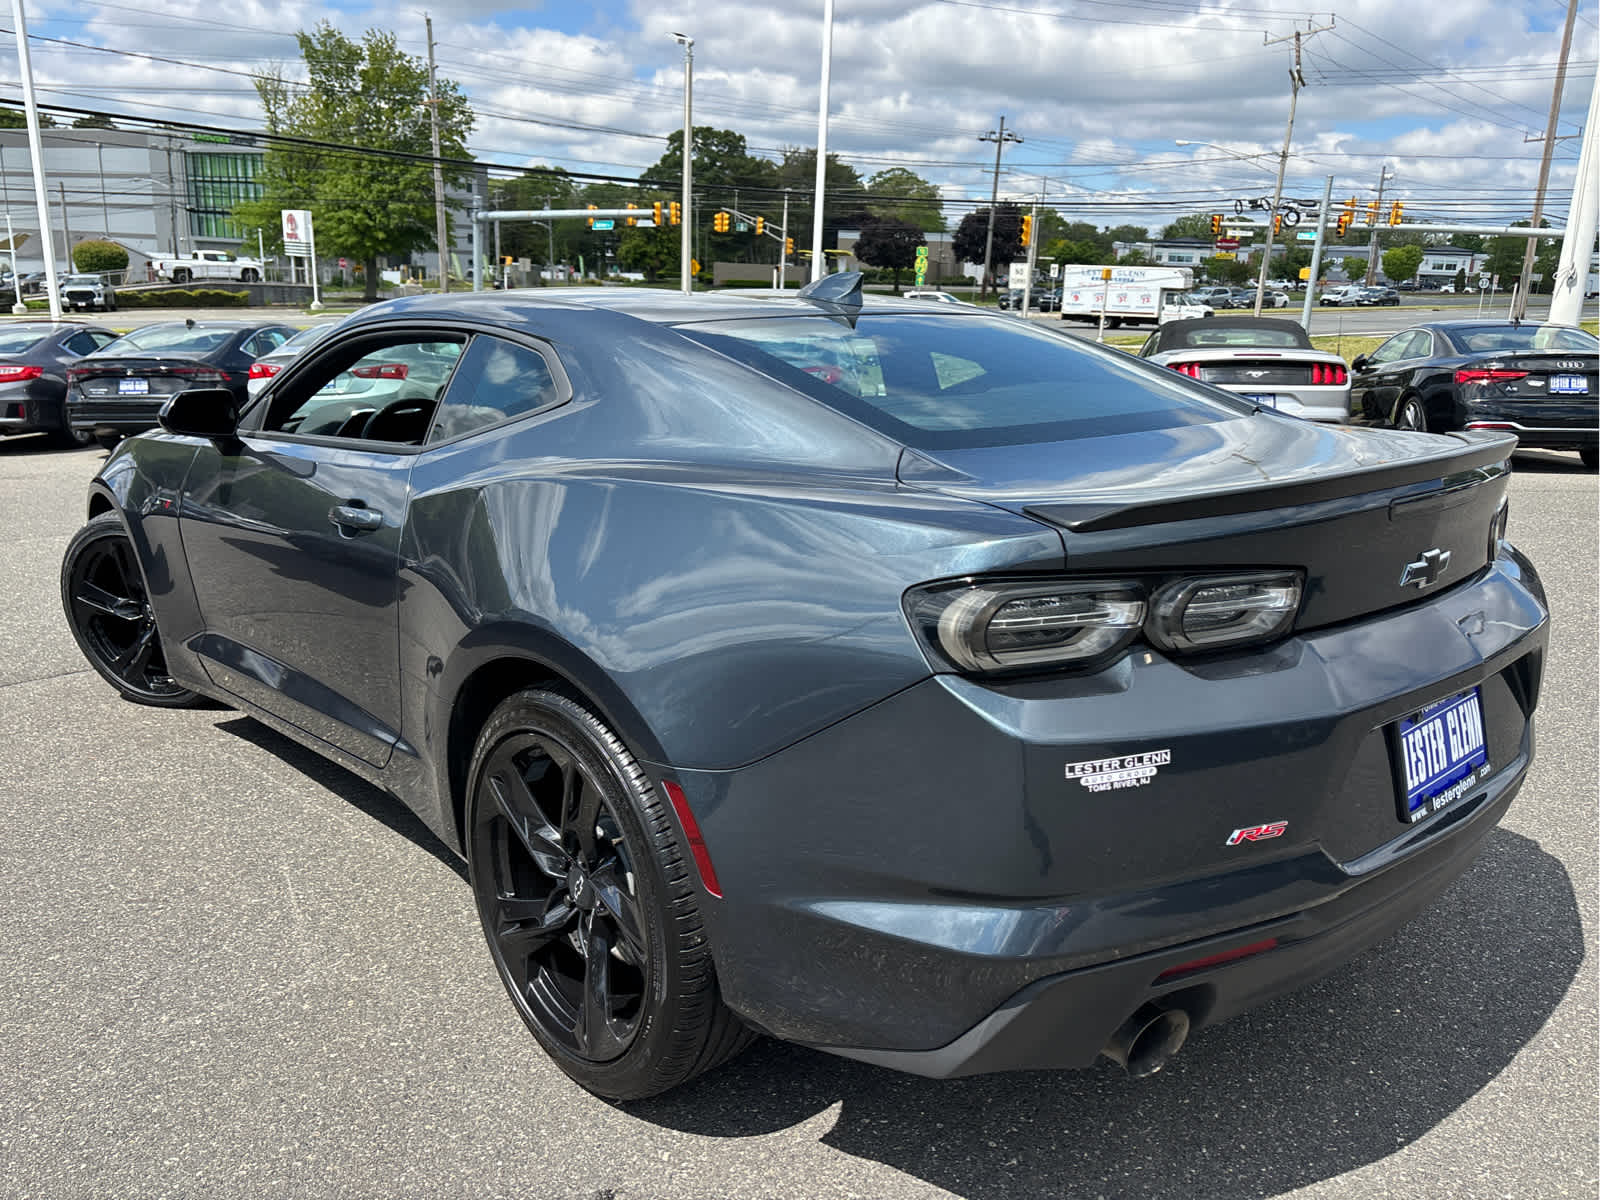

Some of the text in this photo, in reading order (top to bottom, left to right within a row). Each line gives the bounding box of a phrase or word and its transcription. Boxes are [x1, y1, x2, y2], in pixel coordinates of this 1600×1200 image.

[1402, 696, 1484, 791] LESTER GLENN
[1065, 751, 1171, 777] LESTER GLENN
[1083, 767, 1155, 785] AUTO GROUP
[1087, 776, 1151, 793] TOMS RIVER, NJ
[1432, 774, 1476, 811] lesterglenn
[1225, 820, 1289, 846] RS
